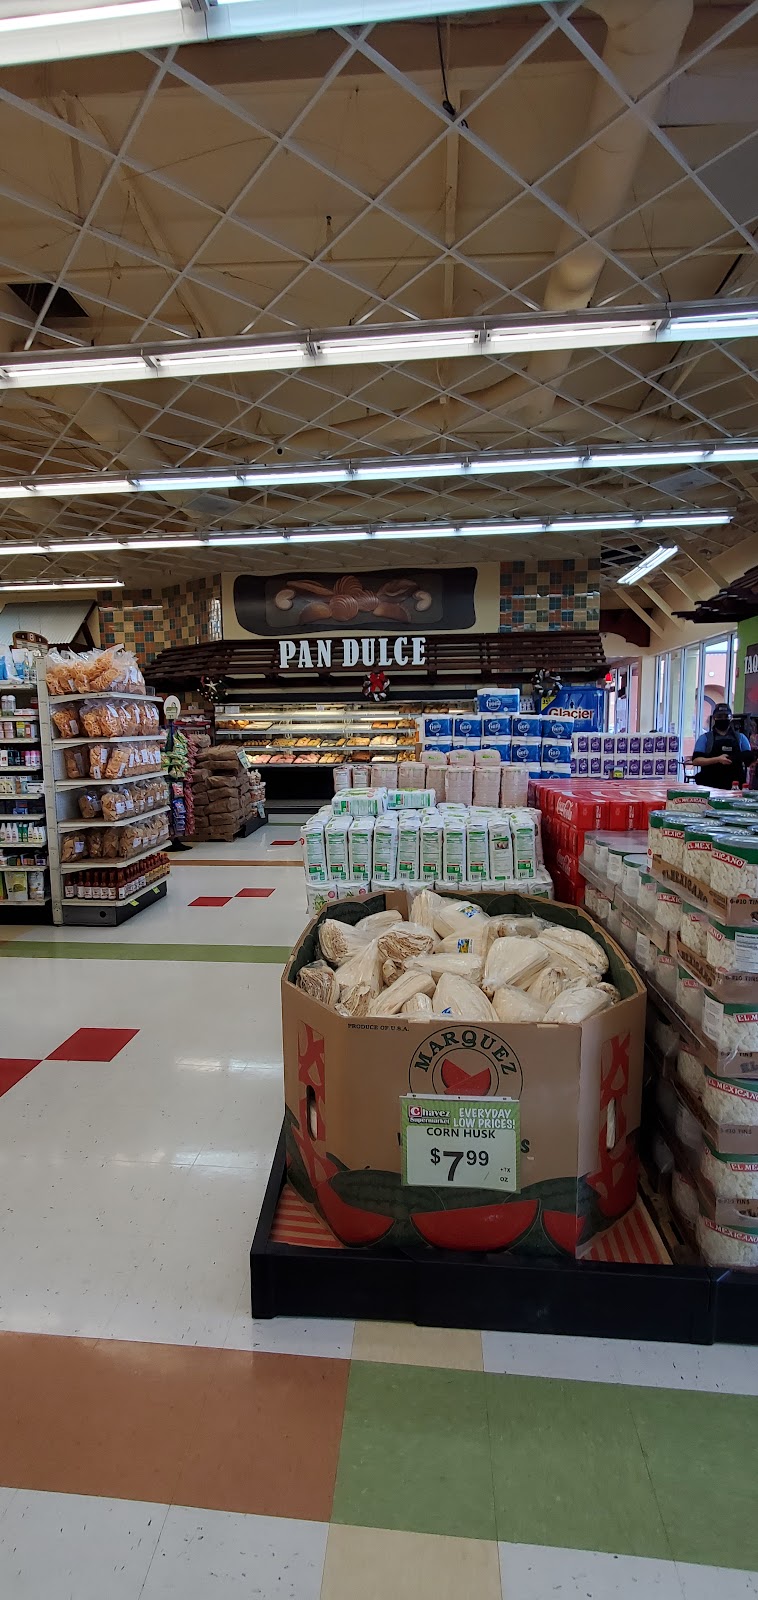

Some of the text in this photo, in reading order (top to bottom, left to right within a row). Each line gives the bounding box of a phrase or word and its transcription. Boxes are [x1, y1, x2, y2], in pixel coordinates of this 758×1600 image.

[278, 637, 426, 669] PAN DULCE
[548, 706, 595, 719] Glacier
[414, 1029, 518, 1076] MARQUEZ
[408, 1105, 450, 1118] Chavez
[459, 1107, 512, 1119] EVERYDAY
[409, 1116, 450, 1125] Supermarket
[453, 1118, 516, 1130] LOW PRICES!
[426, 1127, 496, 1139] CORN HUSK
